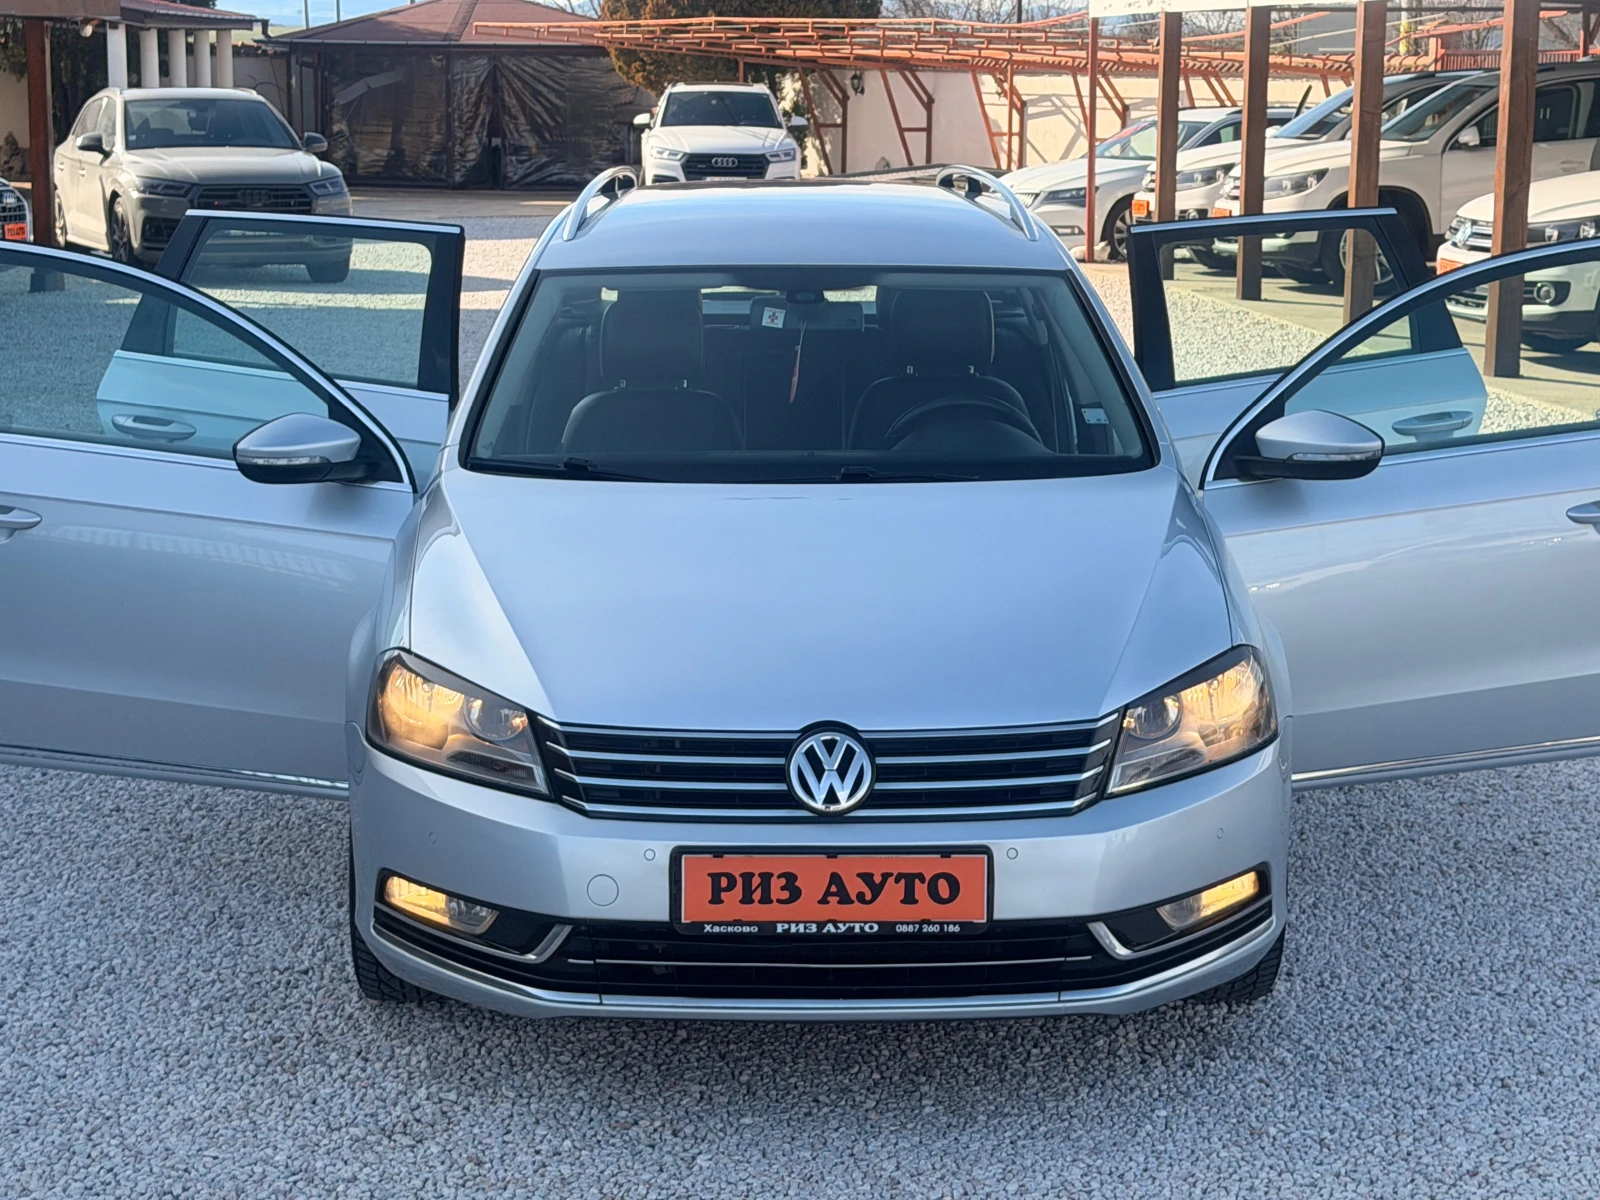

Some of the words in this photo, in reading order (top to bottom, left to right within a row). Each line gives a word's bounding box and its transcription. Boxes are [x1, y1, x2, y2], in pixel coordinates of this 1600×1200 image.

[790, 731, 872, 812] VW
[706, 871, 803, 906] РИЗ
[816, 871, 961, 906] АУТО
[703, 923, 759, 934] Хасково
[776, 922, 818, 934] РИЗ
[821, 922, 880, 934] АУТО
[895, 923, 920, 934] 0887
[922, 923, 940, 934] 260
[943, 923, 961, 934] 186
